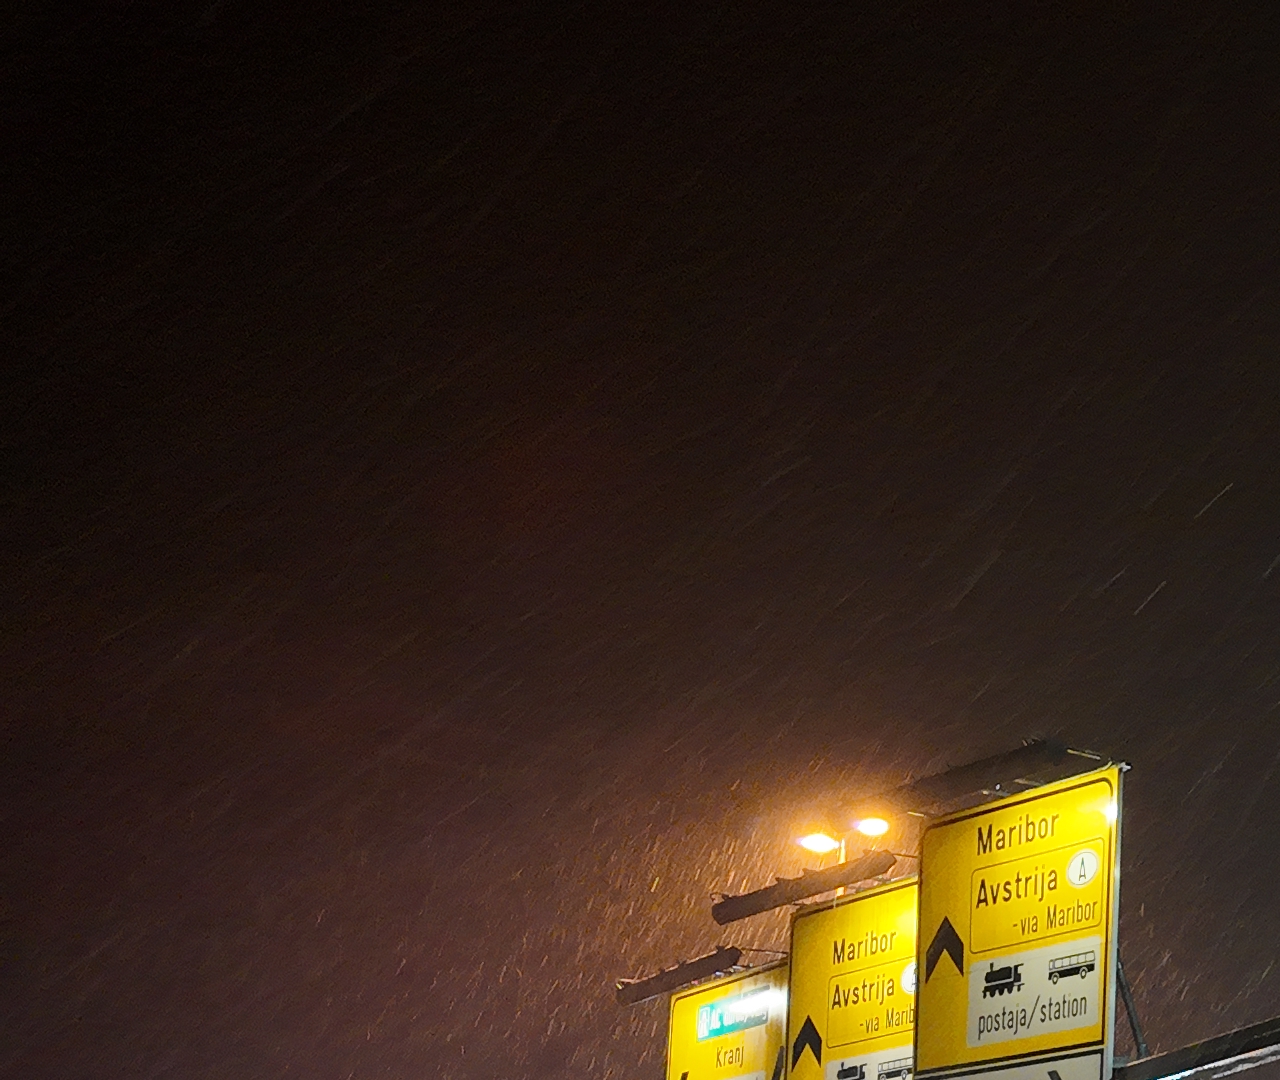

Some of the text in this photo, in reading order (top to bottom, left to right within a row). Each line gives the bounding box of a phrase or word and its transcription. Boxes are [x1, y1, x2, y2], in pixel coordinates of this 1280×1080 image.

[977, 814, 1060, 856] Maribor
[975, 857, 1087, 909] Avstrija A
[1046, 899, 1098, 930] Maribor
[833, 930, 897, 965] Maribor
[831, 974, 895, 1010] Avstrija
[885, 1003, 915, 1029] Marib
[978, 993, 1088, 1040] postaja/station
[715, 1042, 745, 1069] Kranj
